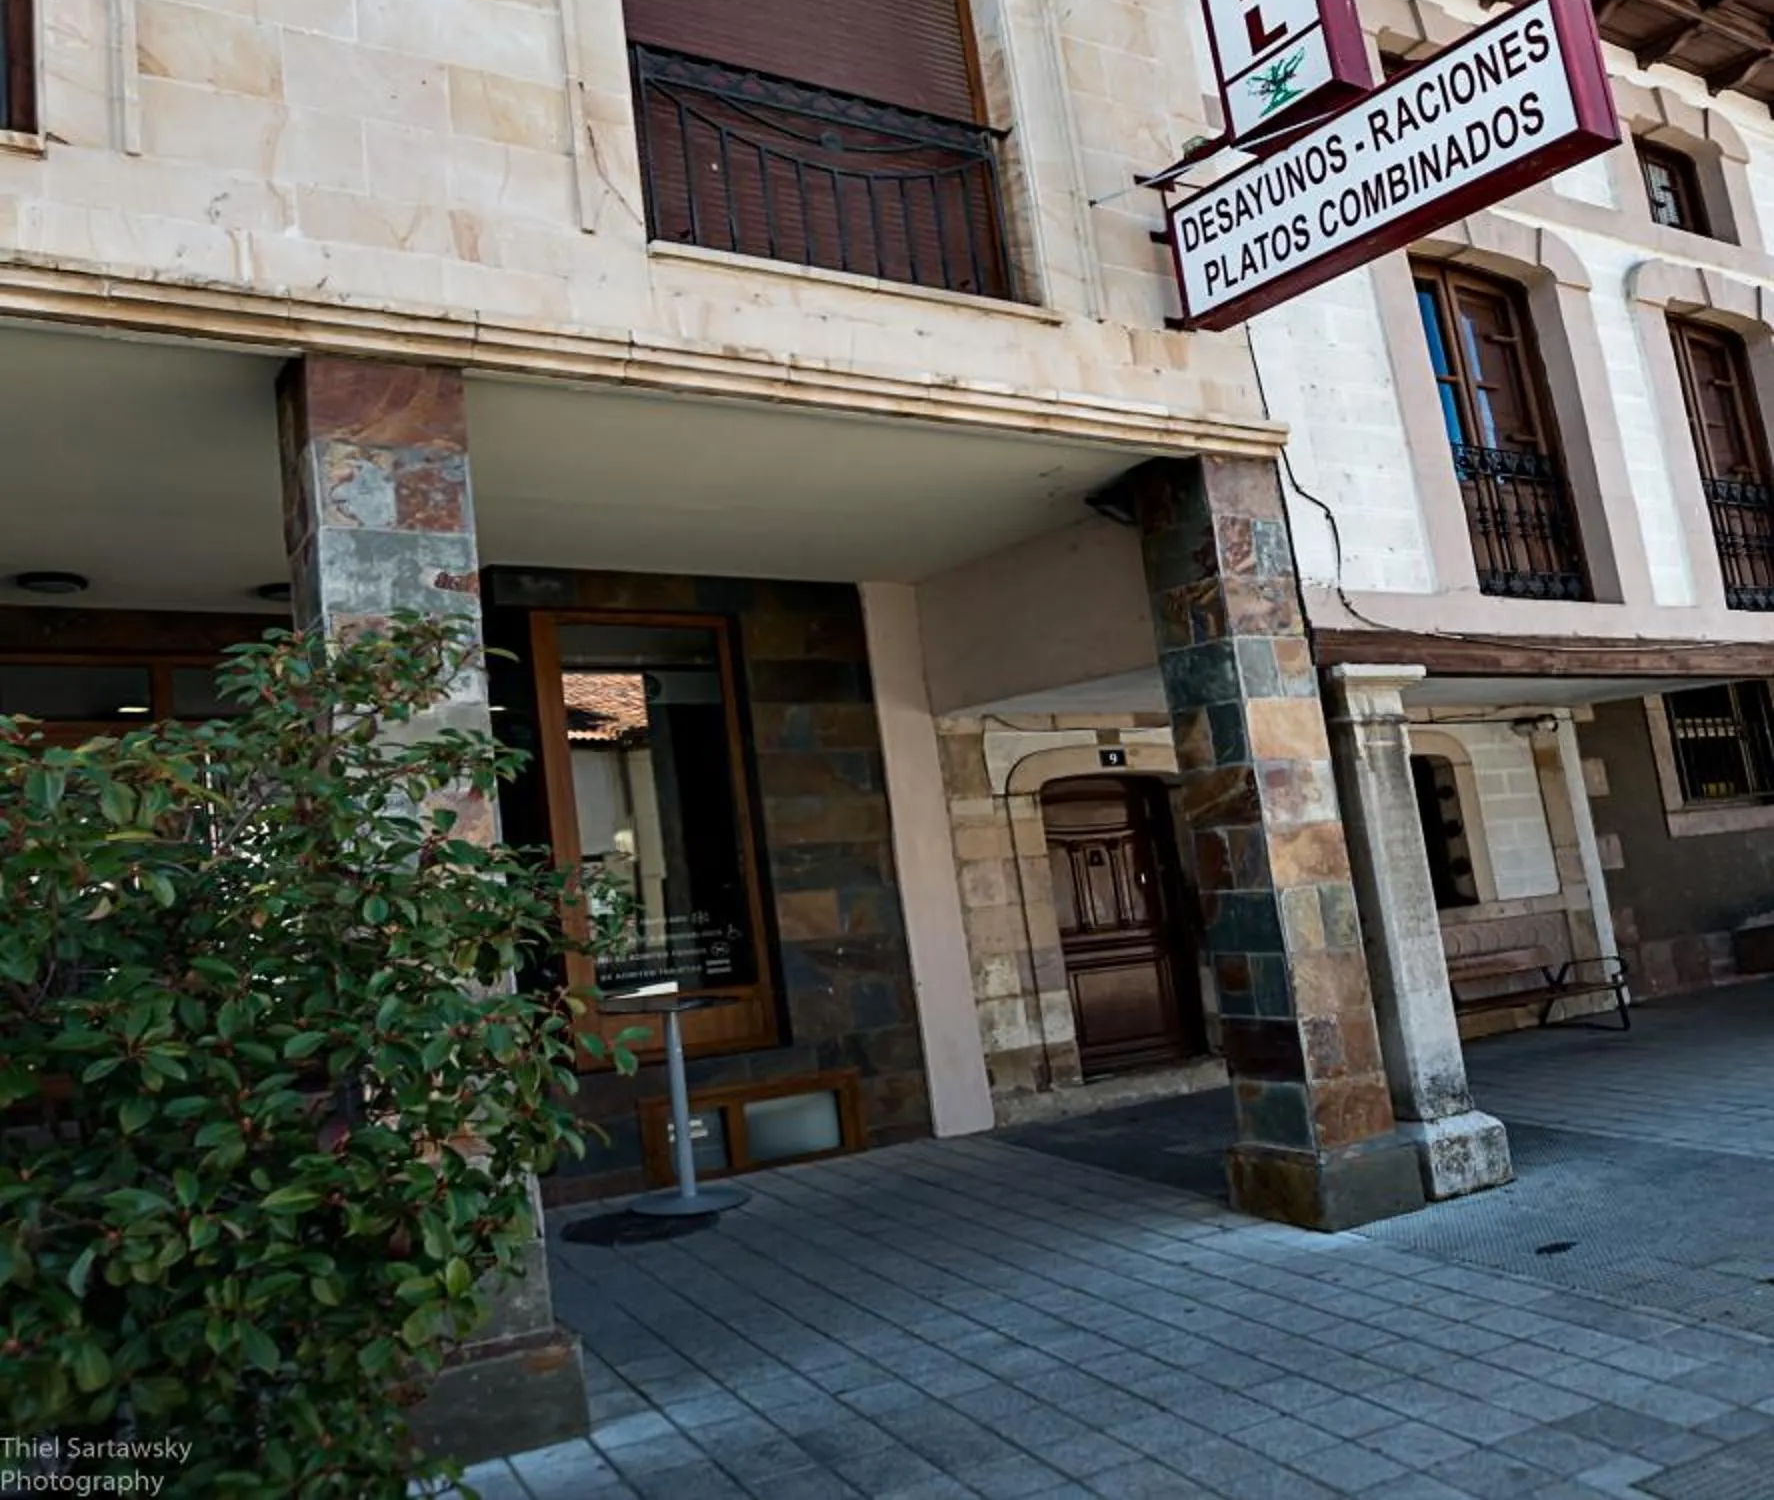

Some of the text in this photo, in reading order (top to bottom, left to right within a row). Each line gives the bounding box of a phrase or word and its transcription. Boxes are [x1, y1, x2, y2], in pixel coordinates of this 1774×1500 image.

[1181, 134, 1348, 253] DESAYUNOS
[1368, 18, 1550, 153] RACIONES
[1204, 92, 1545, 297] PLATOS COMBINADOS
[1109, 753, 1117, 765] 9
